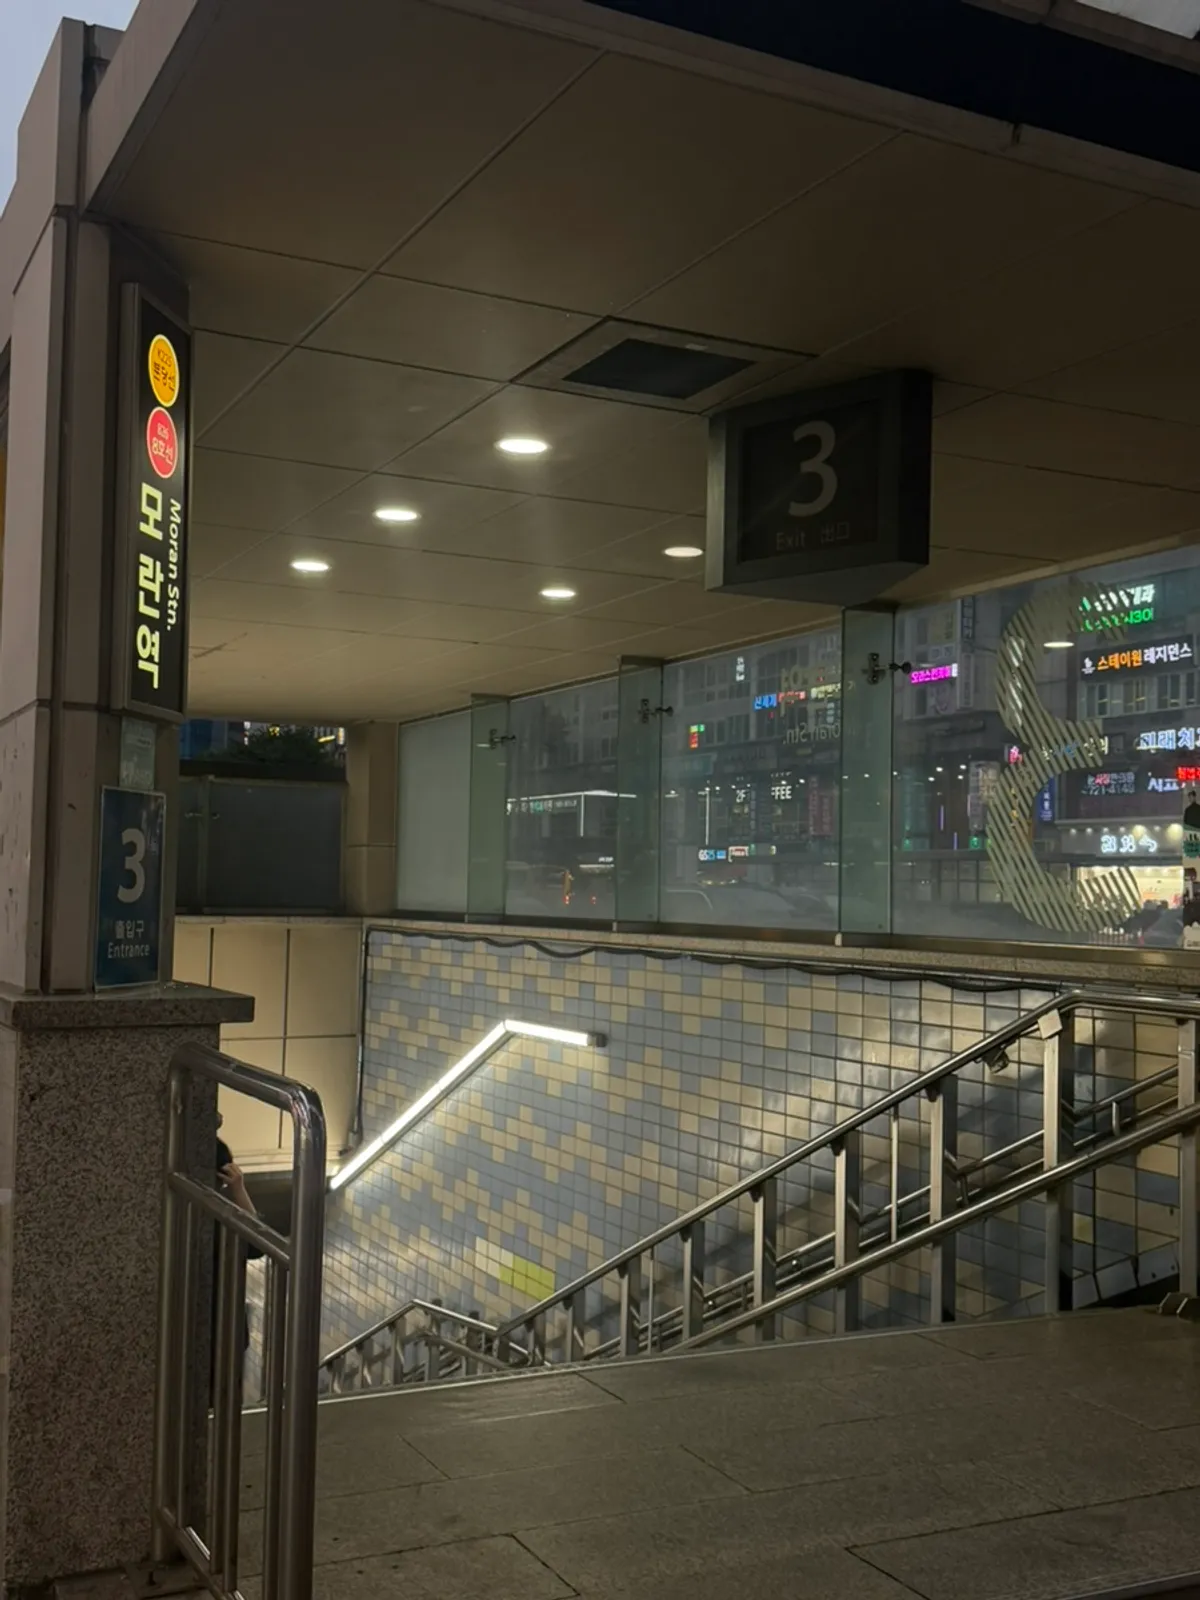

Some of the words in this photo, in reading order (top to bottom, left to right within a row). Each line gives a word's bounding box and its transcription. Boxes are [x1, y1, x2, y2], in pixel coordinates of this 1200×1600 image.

[788, 420, 838, 517] 3
[168, 498, 182, 580] Moran
[775, 531, 806, 551] Exit
[136, 481, 164, 690] 모란역
[166, 584, 180, 632] Stn.
[1097, 649, 1143, 671] 스테이원
[1143, 642, 1193, 665] 레지던스
[117, 827, 146, 904] 3
[107, 941, 150, 959] Entrance
[115, 919, 145, 941] 출입구
